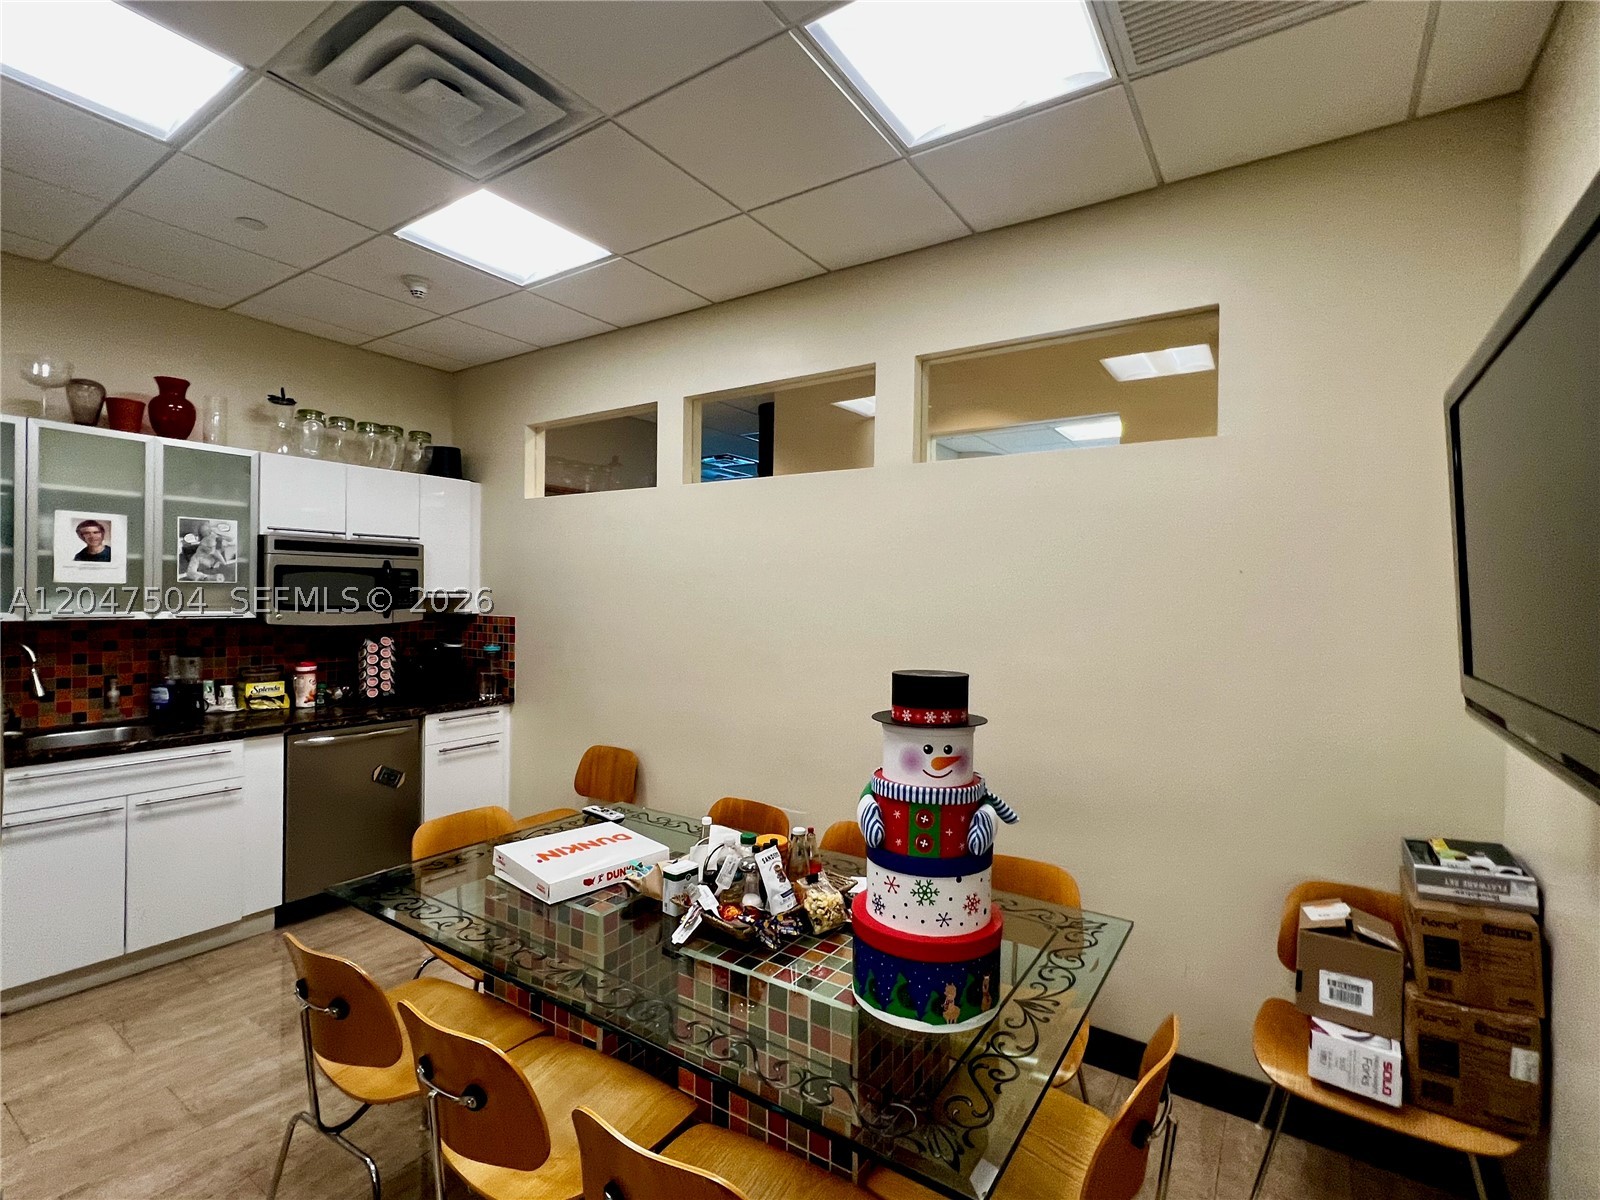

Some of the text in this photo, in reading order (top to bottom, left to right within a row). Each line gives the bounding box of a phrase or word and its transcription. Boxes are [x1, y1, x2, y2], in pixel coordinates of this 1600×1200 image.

[250, 683, 281, 696] Splenda
[605, 863, 640, 882] DUN
[1361, 1056, 1373, 1087] Forks
[1382, 1060, 1393, 1098] SOLO
